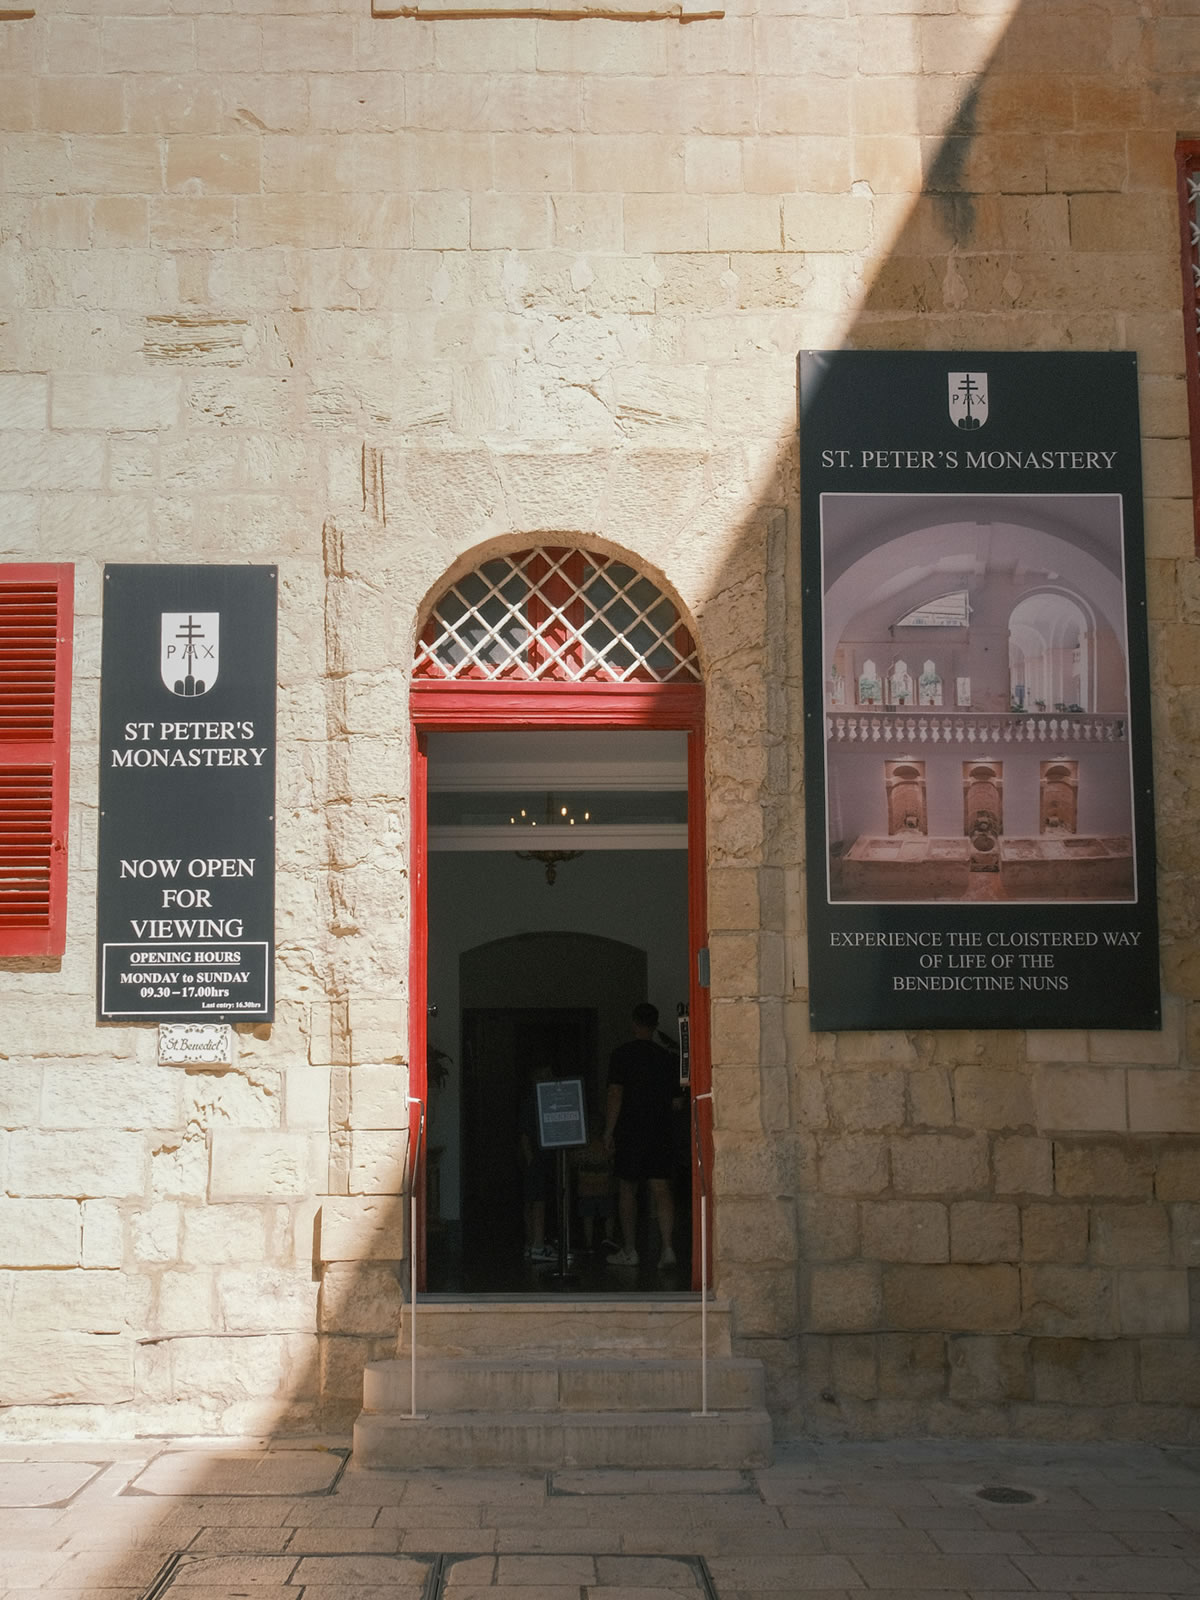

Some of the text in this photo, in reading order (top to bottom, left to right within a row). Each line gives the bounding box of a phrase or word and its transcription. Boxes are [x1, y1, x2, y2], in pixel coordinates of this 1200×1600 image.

[821, 450, 853, 468] ST.
[966, 451, 1118, 470] MONASTERY
[124, 722, 255, 741] ST PETER'S
[111, 748, 268, 768] MONASTERY
[120, 858, 256, 878] NOW OPEN
[162, 889, 213, 908] FOR
[130, 918, 244, 938] VIEWING
[830, 931, 1142, 947] EXPERIENCE THE CLOISTERED WAY
[130, 951, 241, 964] OPENING HOURS
[919, 954, 1055, 969] OF LIFE OF THE
[120, 972, 250, 984] MONDAY to SUNDAY
[892, 976, 1069, 991] BENEDICTINE NUNS
[140, 987, 171, 998] 09.30
[182, 987, 230, 998] 17.00hrs
[181, 1038, 221, 1051] Benedict
